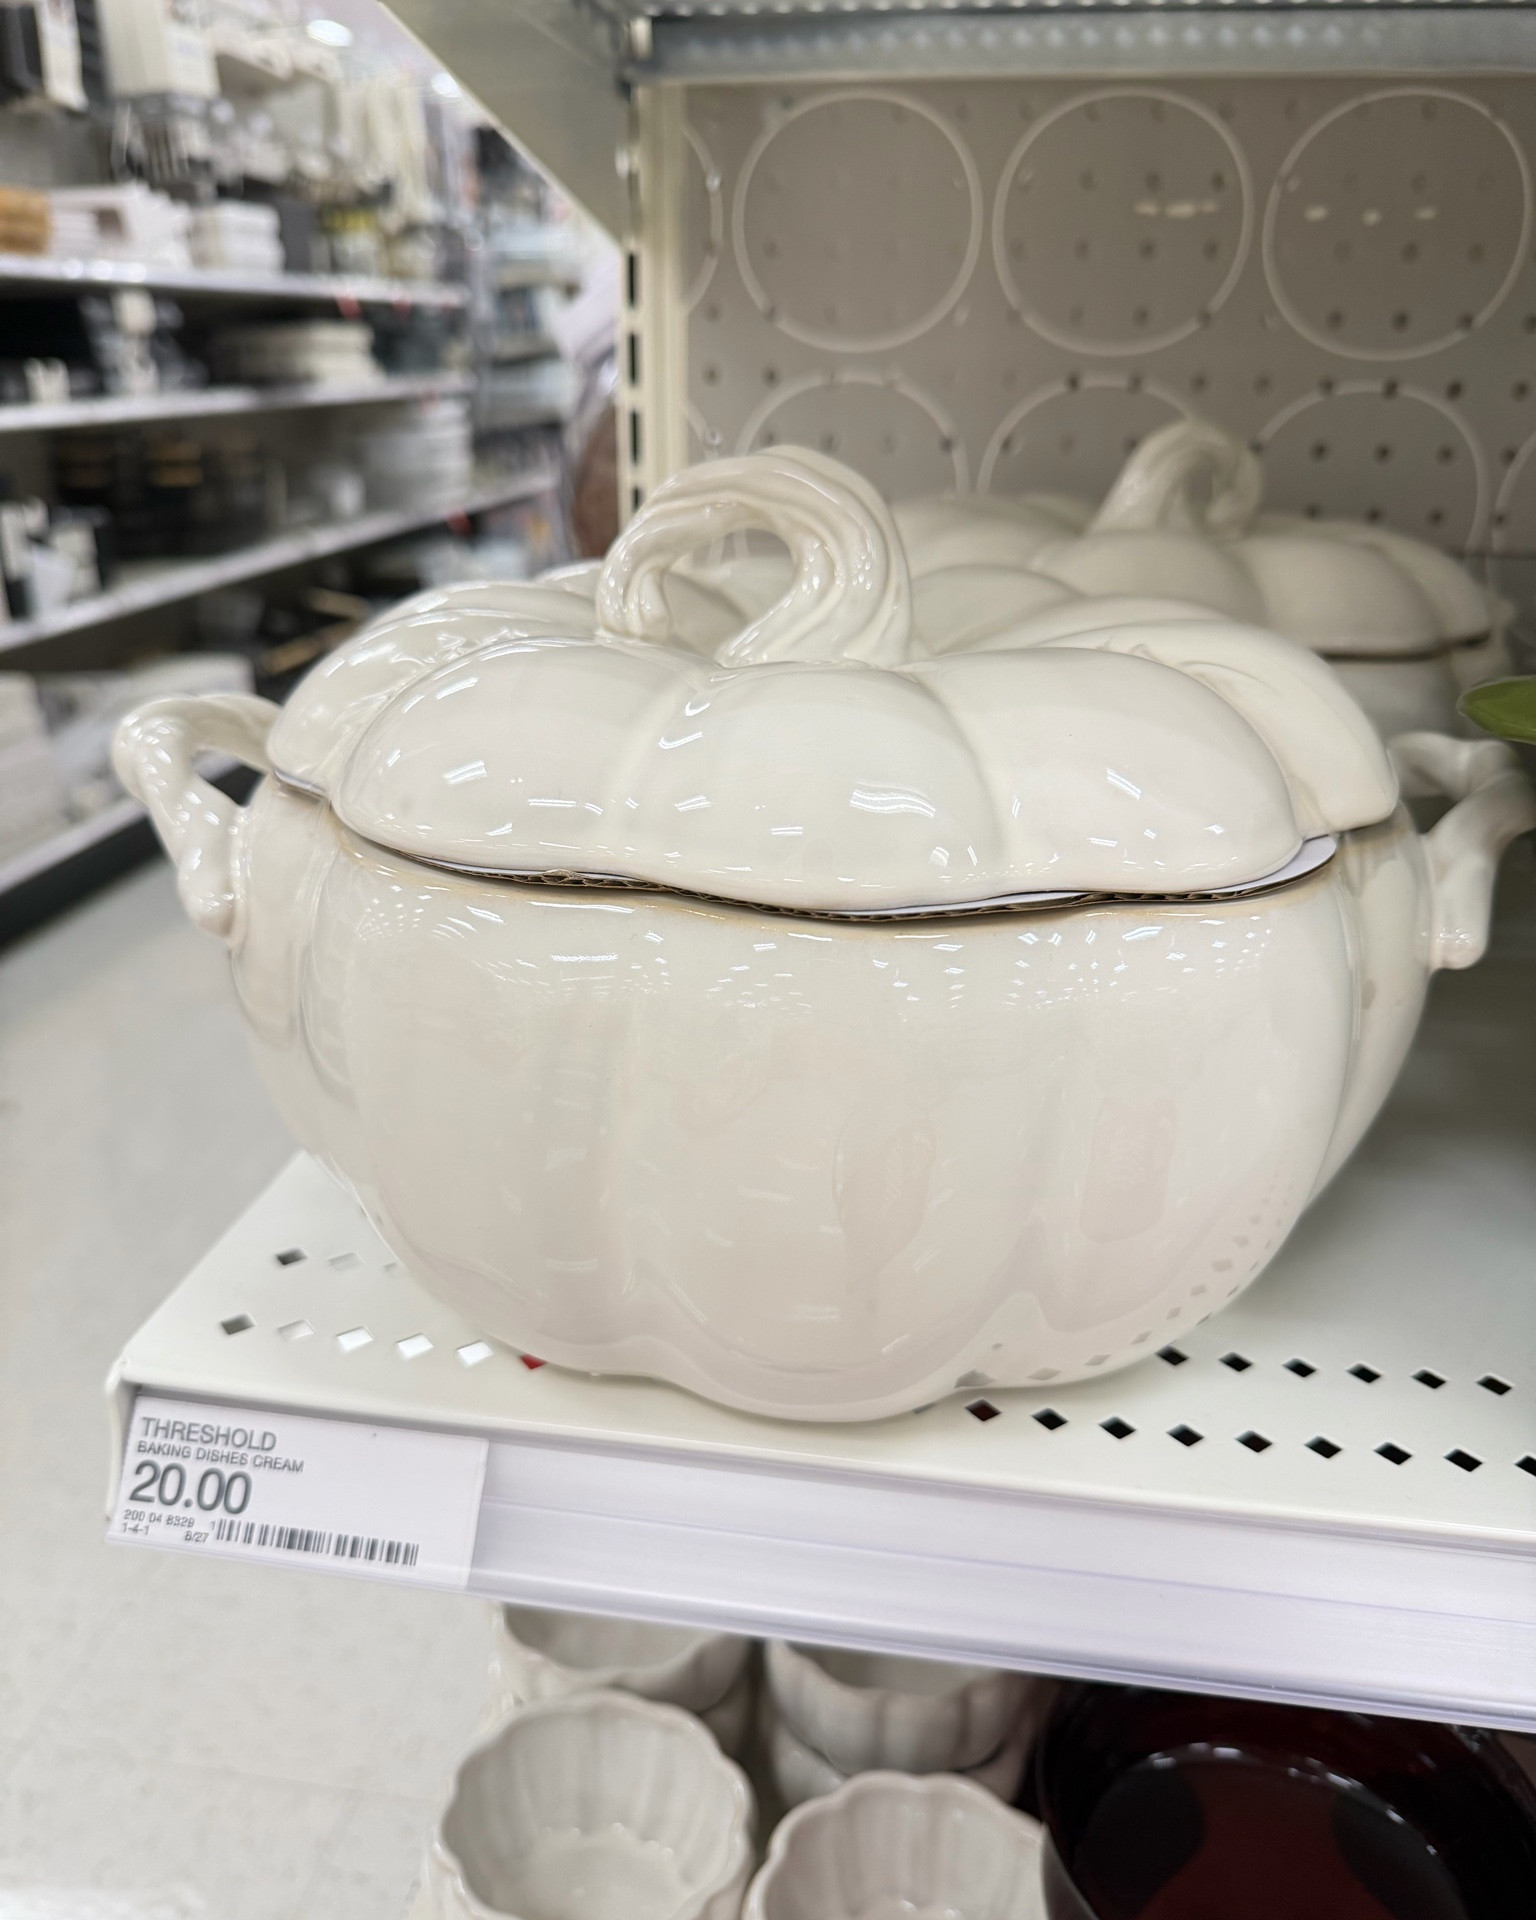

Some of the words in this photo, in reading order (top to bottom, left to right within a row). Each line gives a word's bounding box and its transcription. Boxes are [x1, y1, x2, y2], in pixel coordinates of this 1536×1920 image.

[142, 1417, 277, 1451] THRESHOLD
[137, 1440, 191, 1459] BAKING
[196, 1447, 249, 1466] DISHES
[253, 1454, 305, 1473] CREAM
[129, 1459, 253, 1515] 20.00
[122, 1522, 150, 1535] 1-4-1
